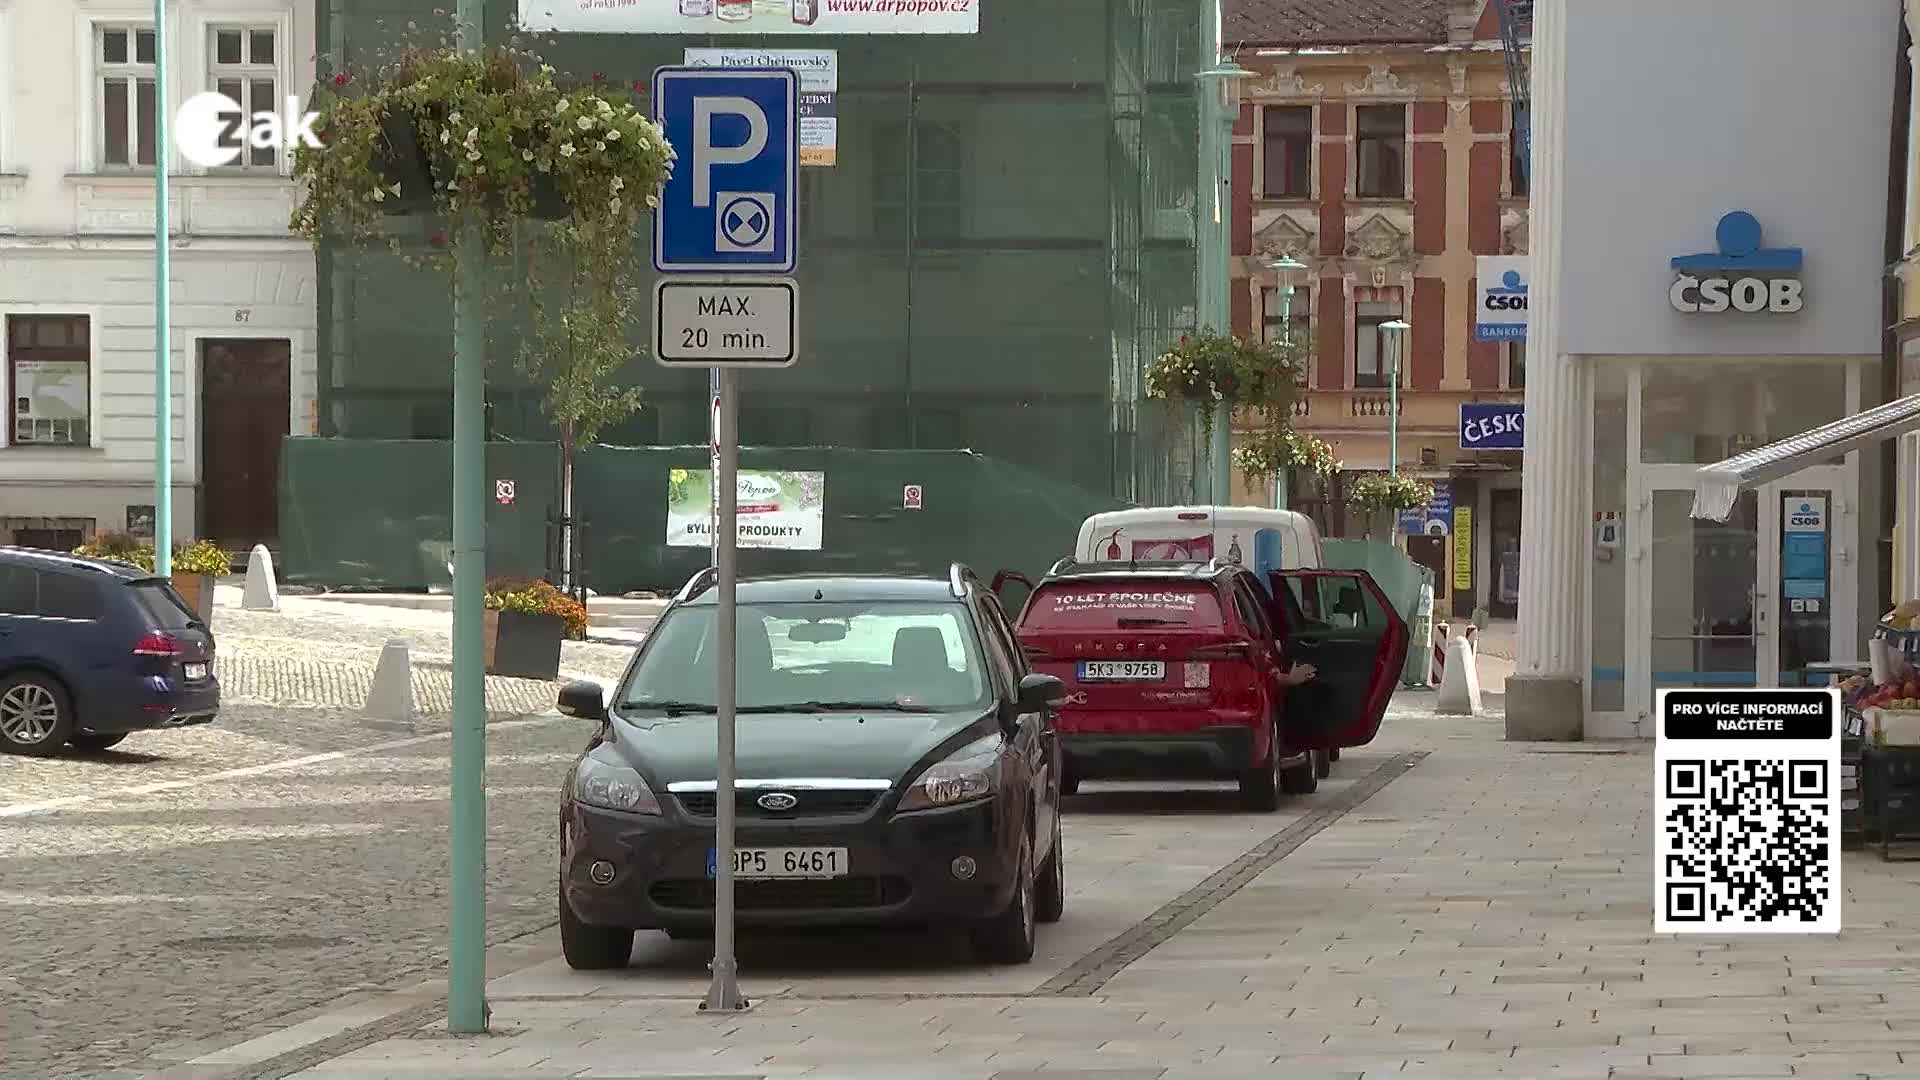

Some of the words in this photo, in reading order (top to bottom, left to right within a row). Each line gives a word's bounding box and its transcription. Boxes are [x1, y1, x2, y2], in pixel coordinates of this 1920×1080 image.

[827, 0, 970, 15] www.drpopov.cz
[720, 55, 754, 67] Pavel
[692, 95, 769, 208] P
[1669, 272, 1804, 313] ČSOB
[697, 295, 756, 316] MAX.
[681, 327, 709, 348] 20
[721, 327, 771, 348] min.
[1481, 327, 1527, 337] BANKOM
[1464, 412, 1525, 442] ČESK
[738, 524, 802, 537] PRODUKTY
[1055, 595, 1074, 604] 10
[1076, 593, 1107, 603] LET
[784, 851, 837, 872] 6461
